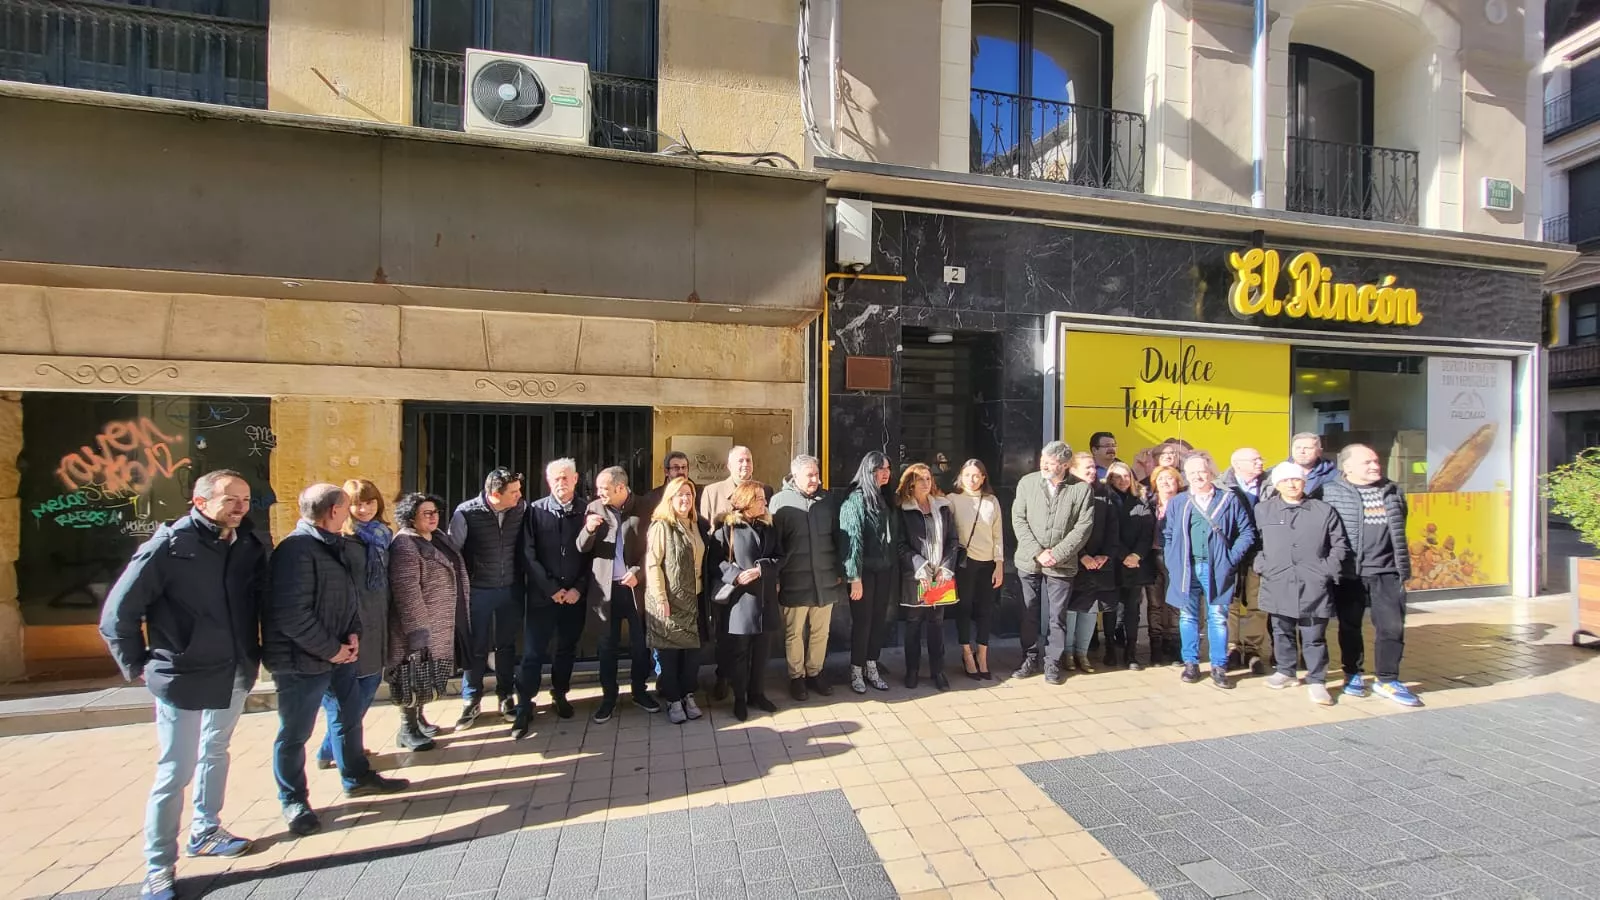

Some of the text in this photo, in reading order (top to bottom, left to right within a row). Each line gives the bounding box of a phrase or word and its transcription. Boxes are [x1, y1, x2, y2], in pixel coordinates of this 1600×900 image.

[951, 268, 959, 281] 2
[1230, 248, 1424, 326] El Rincón
[1140, 344, 1217, 385] Dulce
[1120, 386, 1234, 427] Tentación
